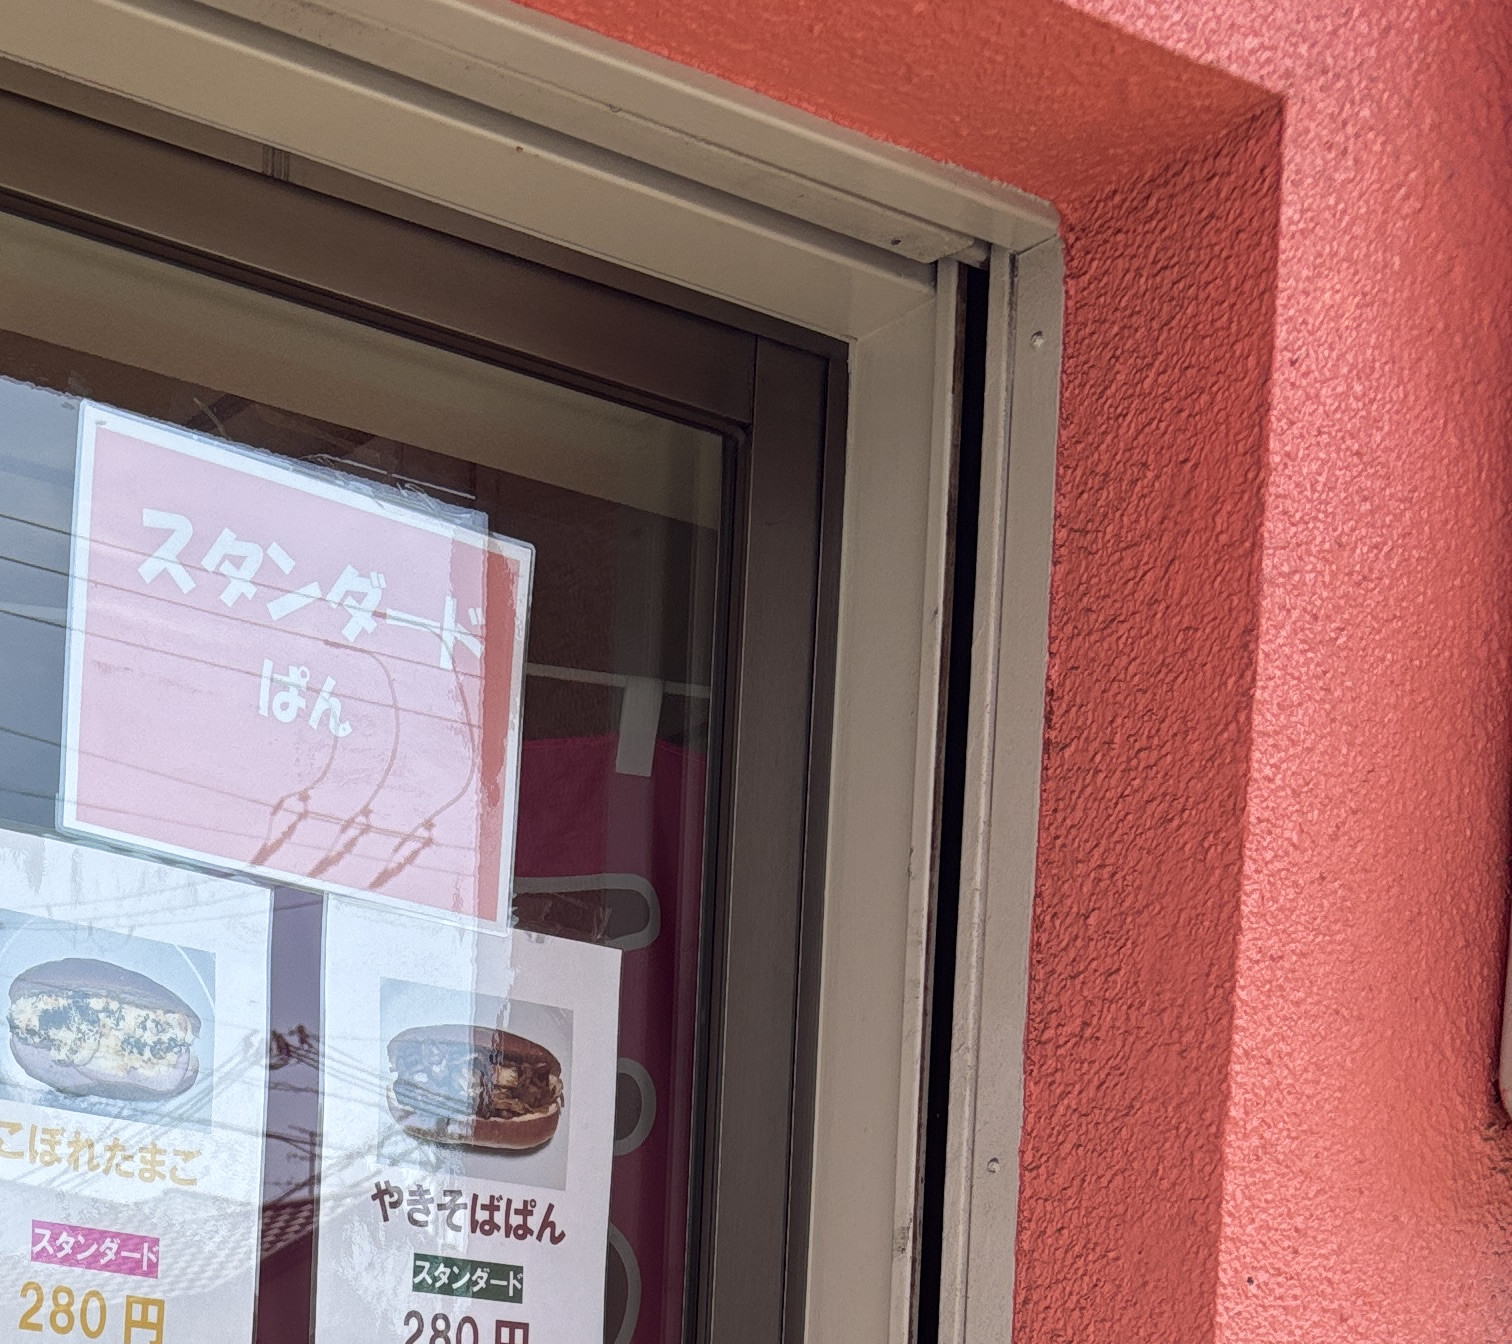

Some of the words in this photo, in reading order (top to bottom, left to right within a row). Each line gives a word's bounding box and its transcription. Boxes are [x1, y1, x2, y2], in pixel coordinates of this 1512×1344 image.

[137, 508, 486, 670] スタンダード
[259, 657, 353, 738] ぱん
[371, 1181, 566, 1245] やきそばぱん
[31, 1223, 160, 1275] スタンダード
[413, 1259, 524, 1301] スタンダード
